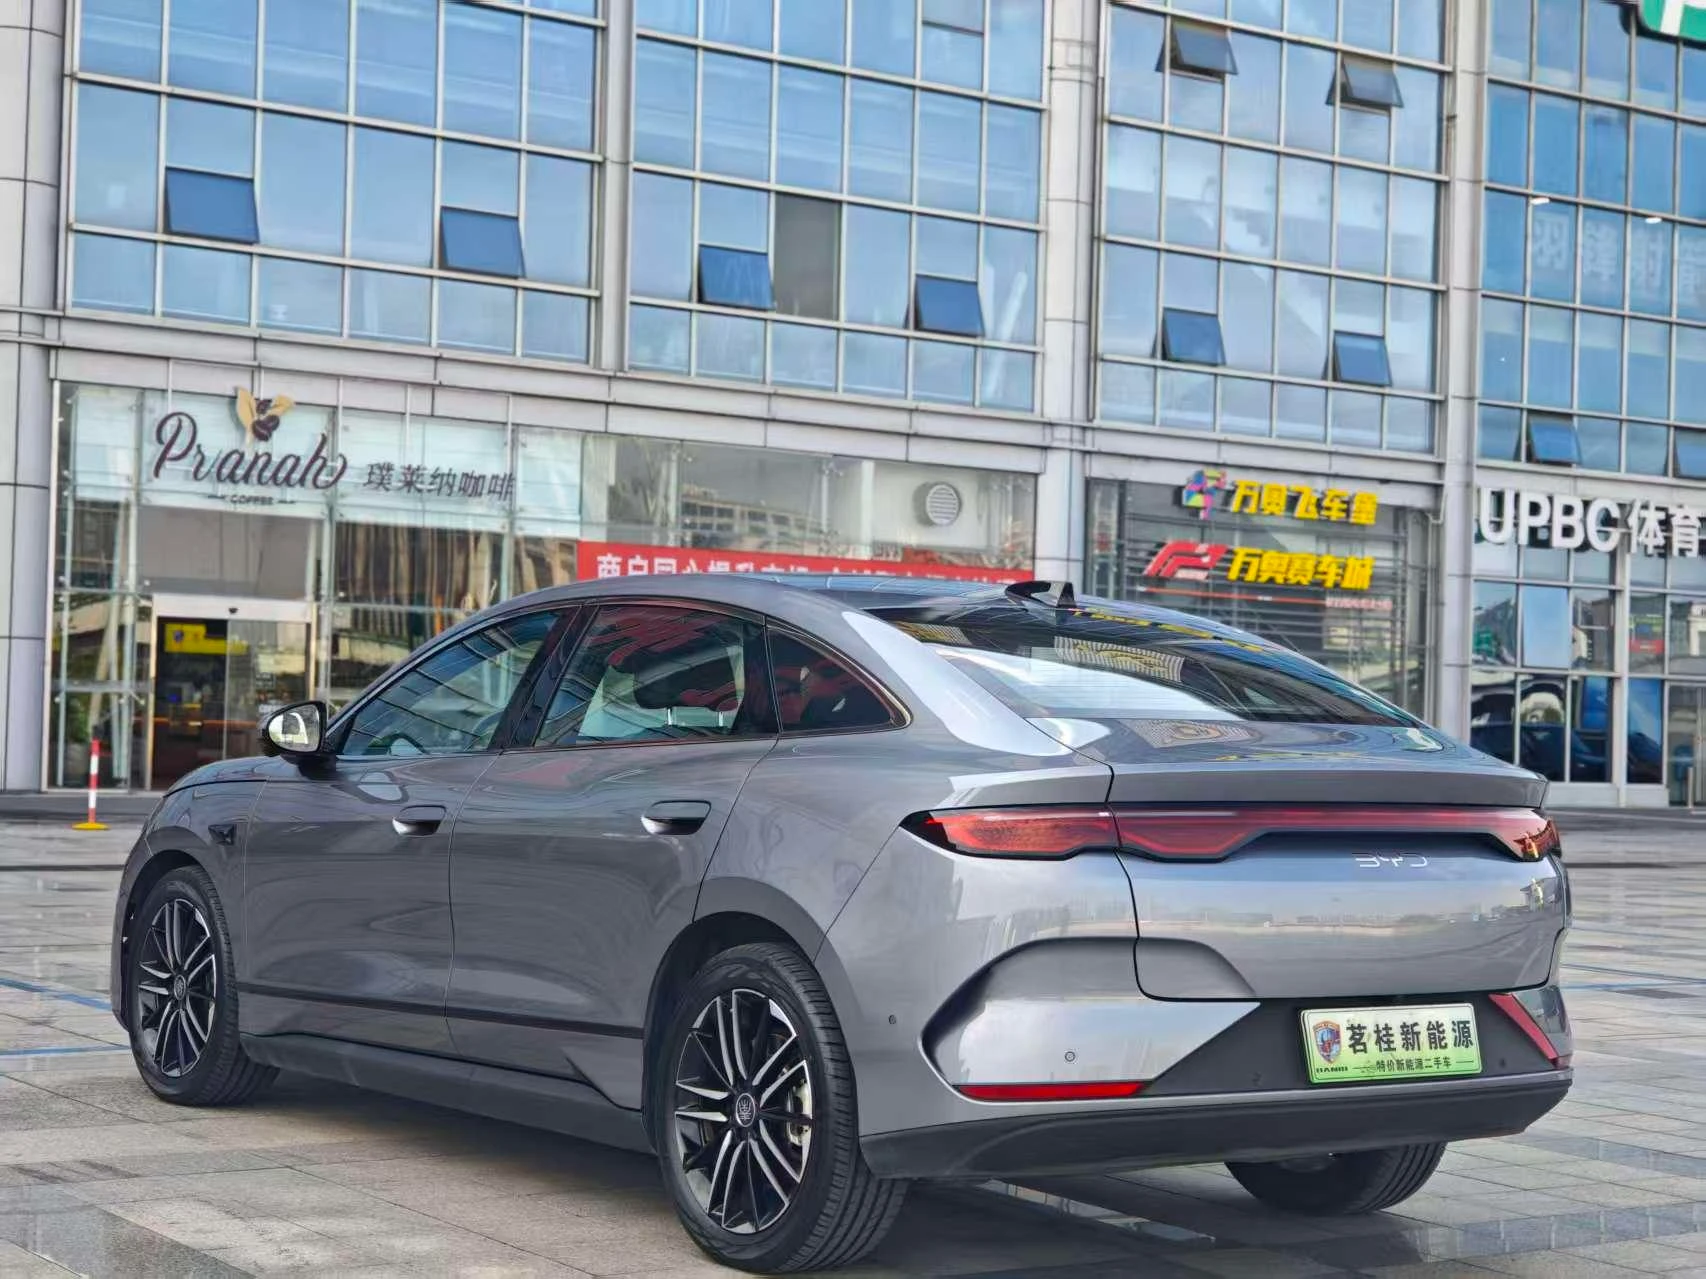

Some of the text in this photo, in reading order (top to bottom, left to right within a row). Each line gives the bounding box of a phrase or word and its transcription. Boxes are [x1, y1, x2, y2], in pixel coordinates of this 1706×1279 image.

[153, 411, 348, 490] Pranah
[363, 462, 516, 501] 璞莱纳咖啡
[1480, 487, 1701, 557] UPBC 体育
[1352, 852, 1428, 868] BYD
[1346, 1020, 1474, 1054] 茗桂新能源
[1375, 1056, 1452, 1073] 特价新能源二手车
